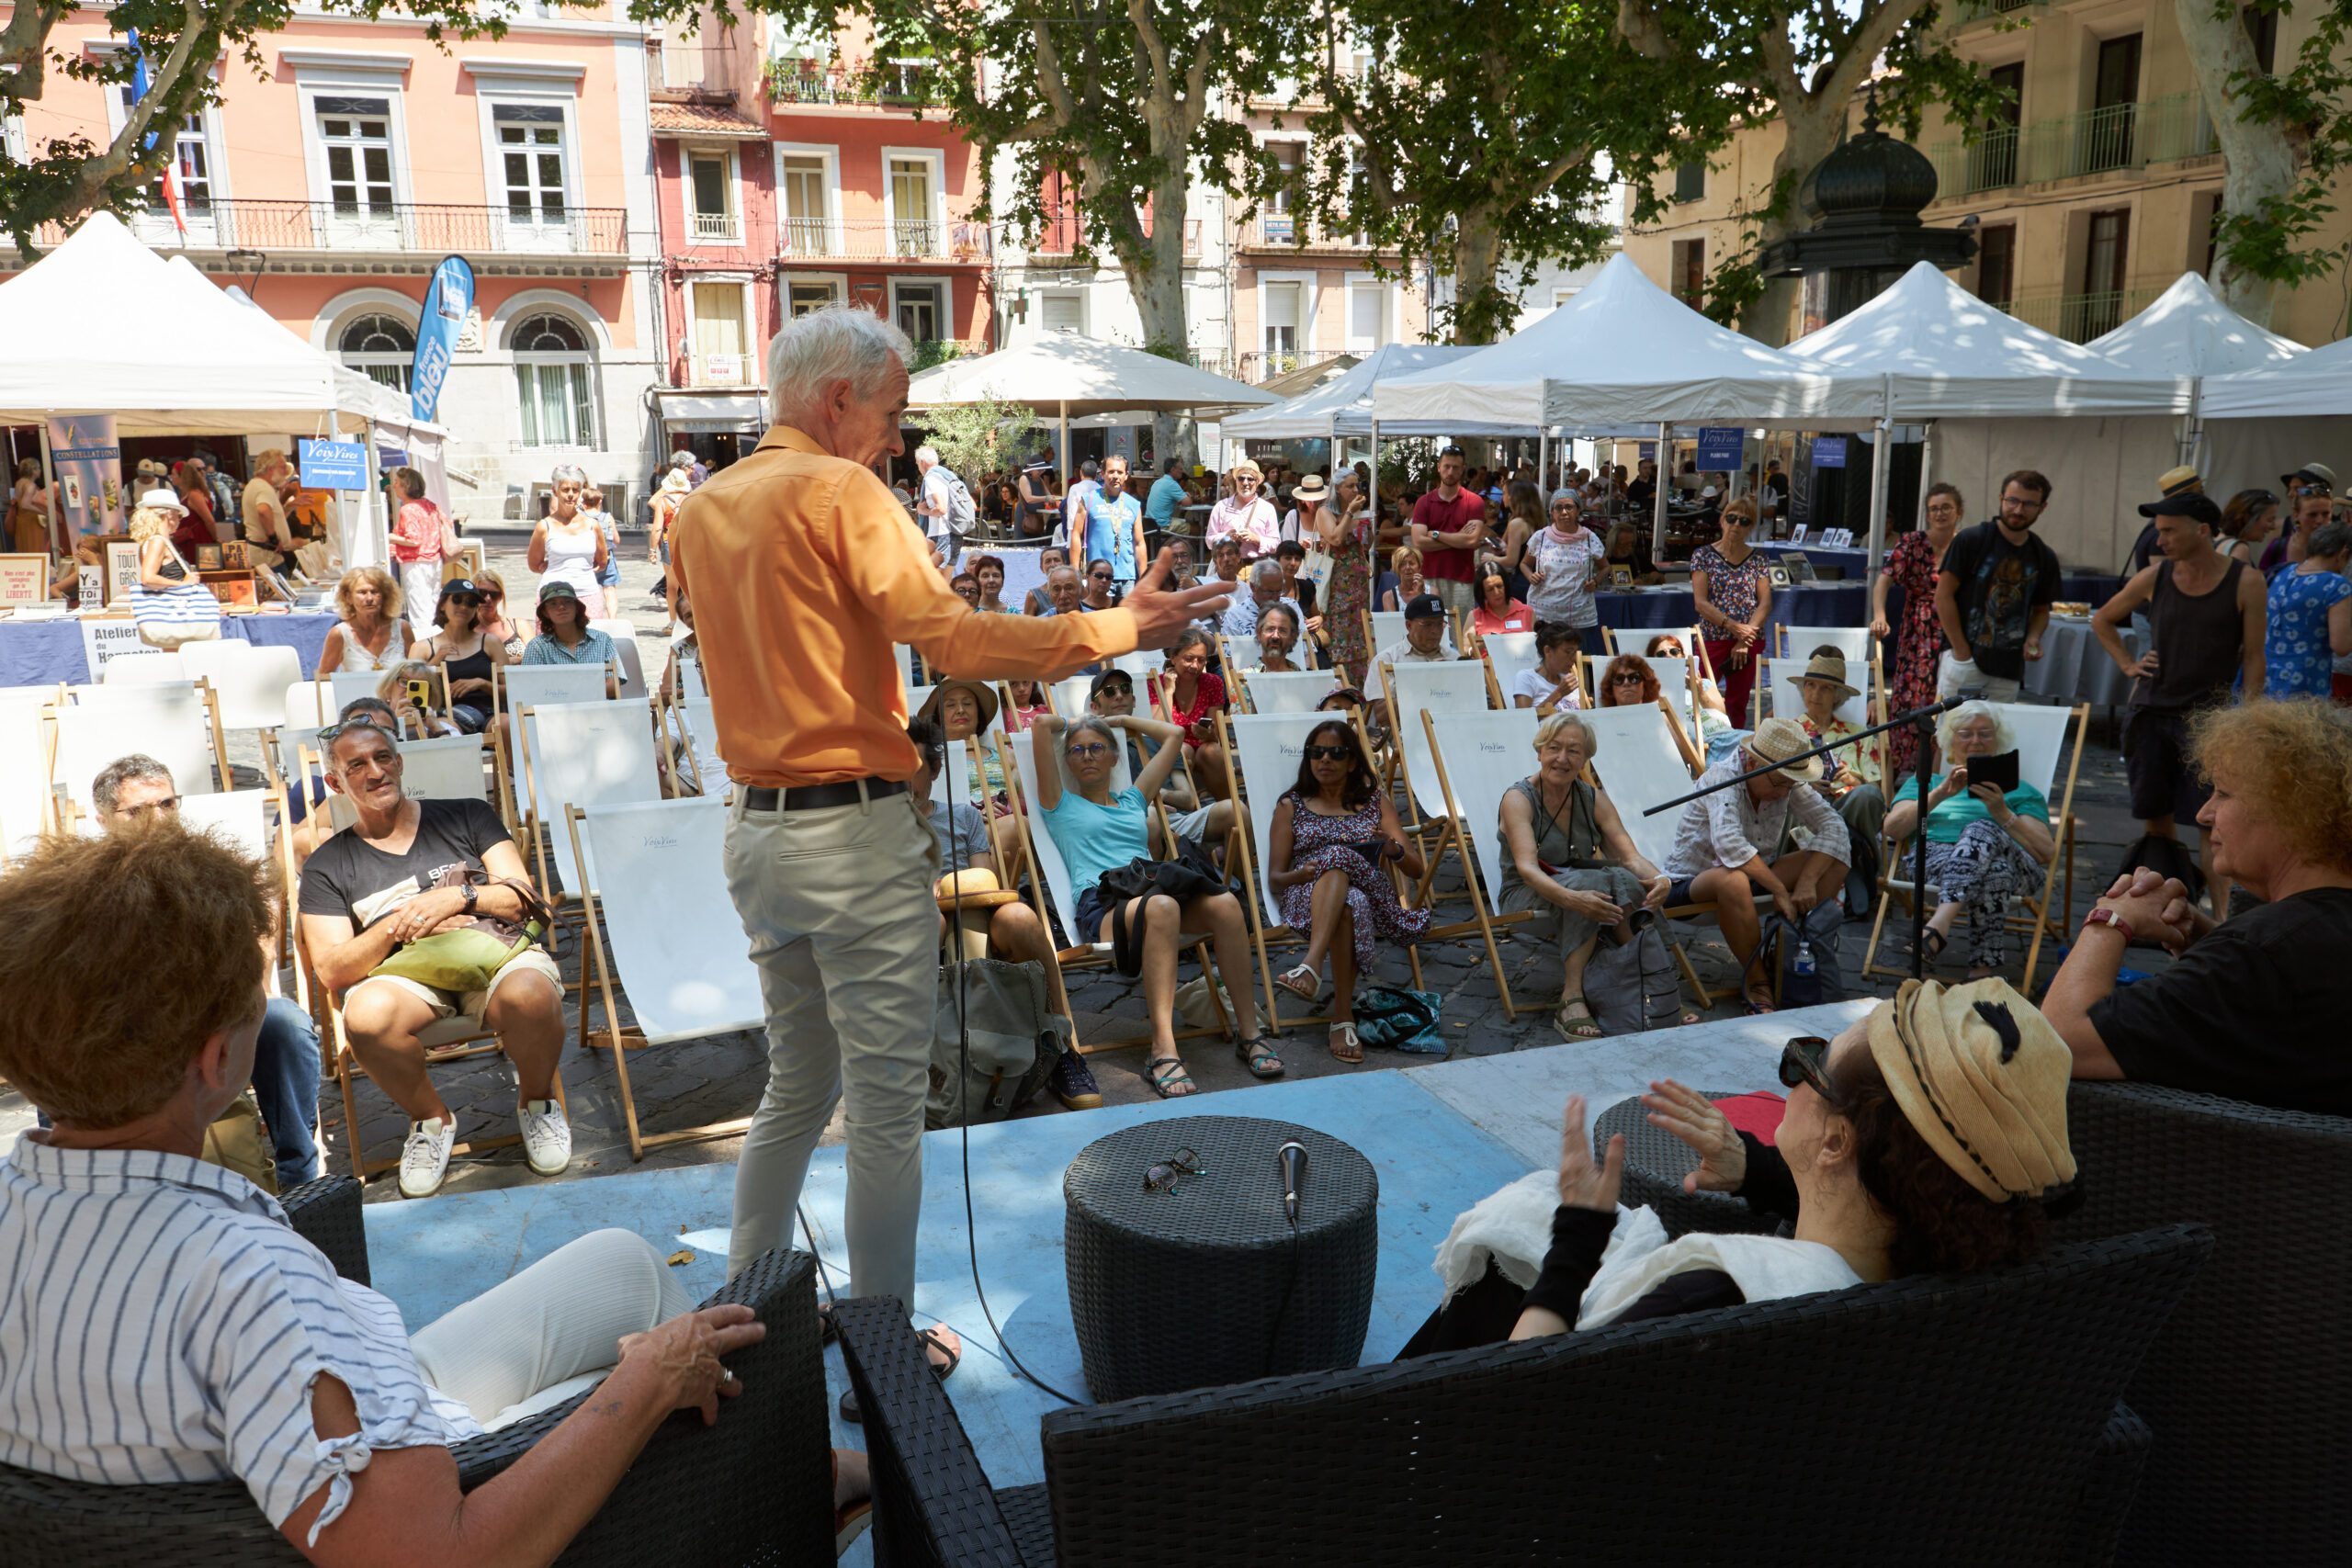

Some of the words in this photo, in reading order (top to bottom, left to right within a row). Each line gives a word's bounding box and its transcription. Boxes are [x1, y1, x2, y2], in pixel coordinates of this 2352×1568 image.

[418, 336, 436, 373] france
[413, 343, 448, 414] bleu
[684, 423, 706, 432] BAR
[710, 423, 725, 432] DE
[56, 448, 118, 459] CONSTELLATIONS
[117, 555, 136, 568] TOUT
[95, 627, 137, 640] Atelier
